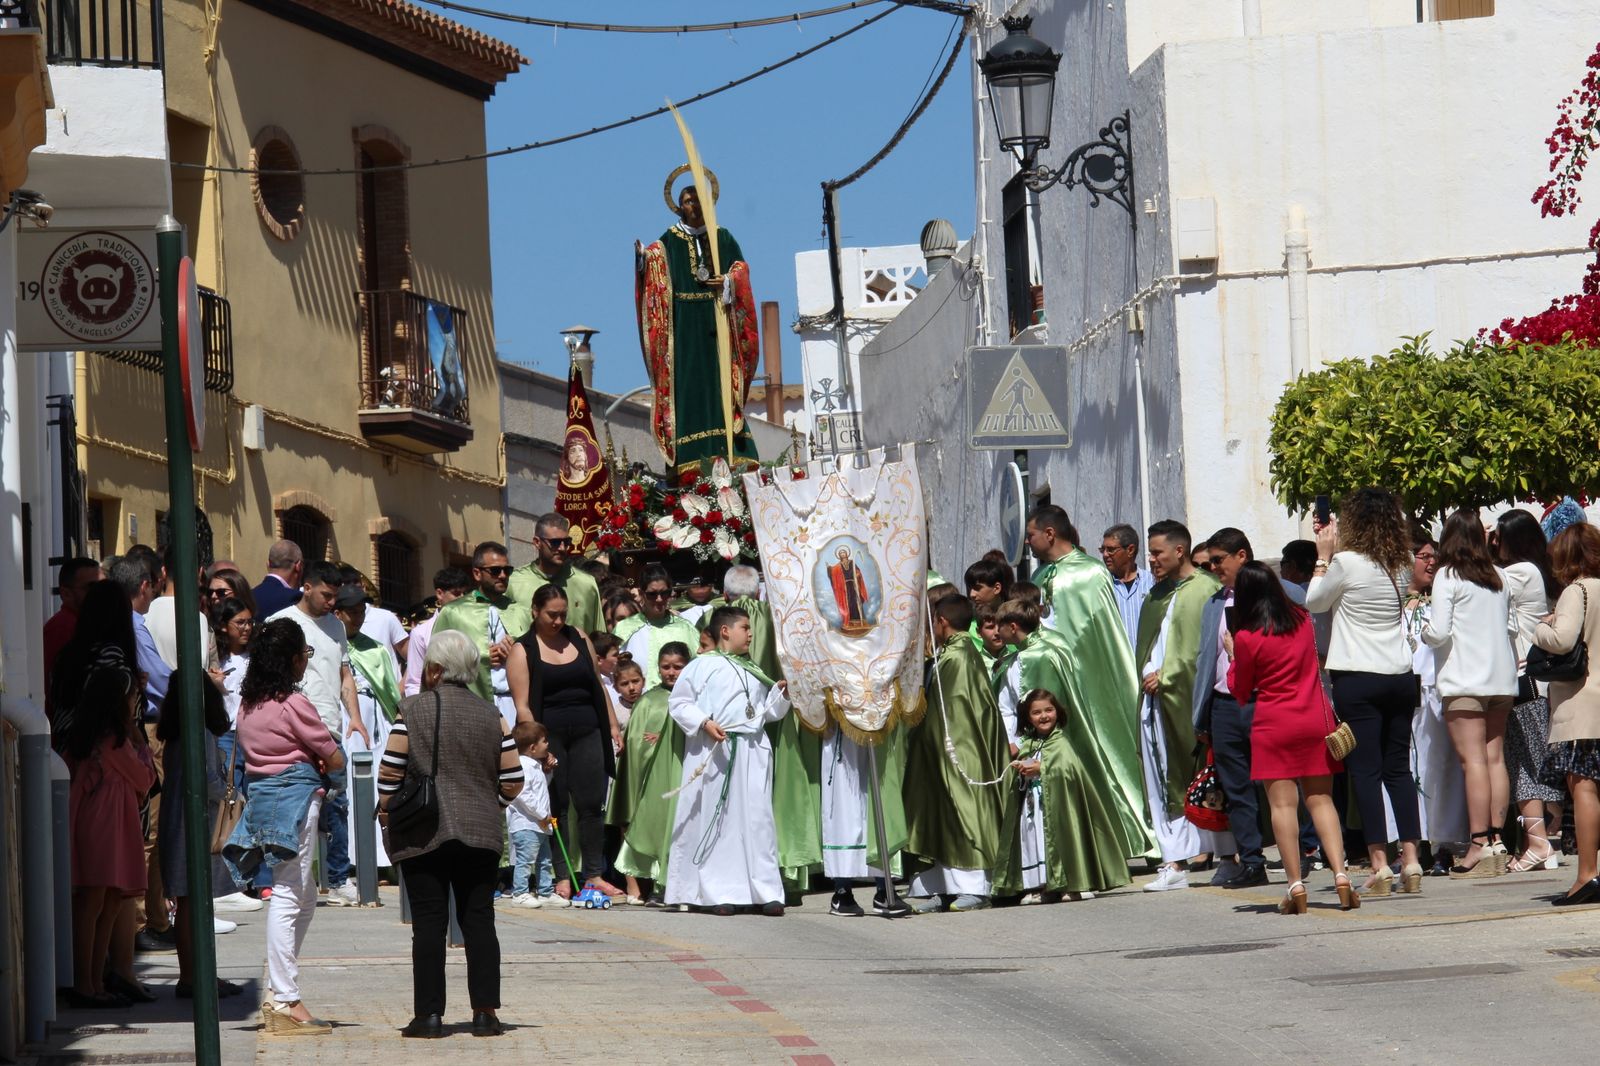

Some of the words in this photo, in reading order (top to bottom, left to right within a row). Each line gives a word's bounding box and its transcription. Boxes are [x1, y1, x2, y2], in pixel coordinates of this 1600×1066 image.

[49, 239, 89, 285] CARNICERÍA
[97, 238, 147, 284] TRADICIONAL
[19, 281, 41, 301] 19
[50, 297, 65, 320] HIJOS
[65, 320, 77, 330] DE
[572, 493, 582, 501] DE
[583, 491, 594, 500] LA
[563, 502, 588, 511] LORCA
